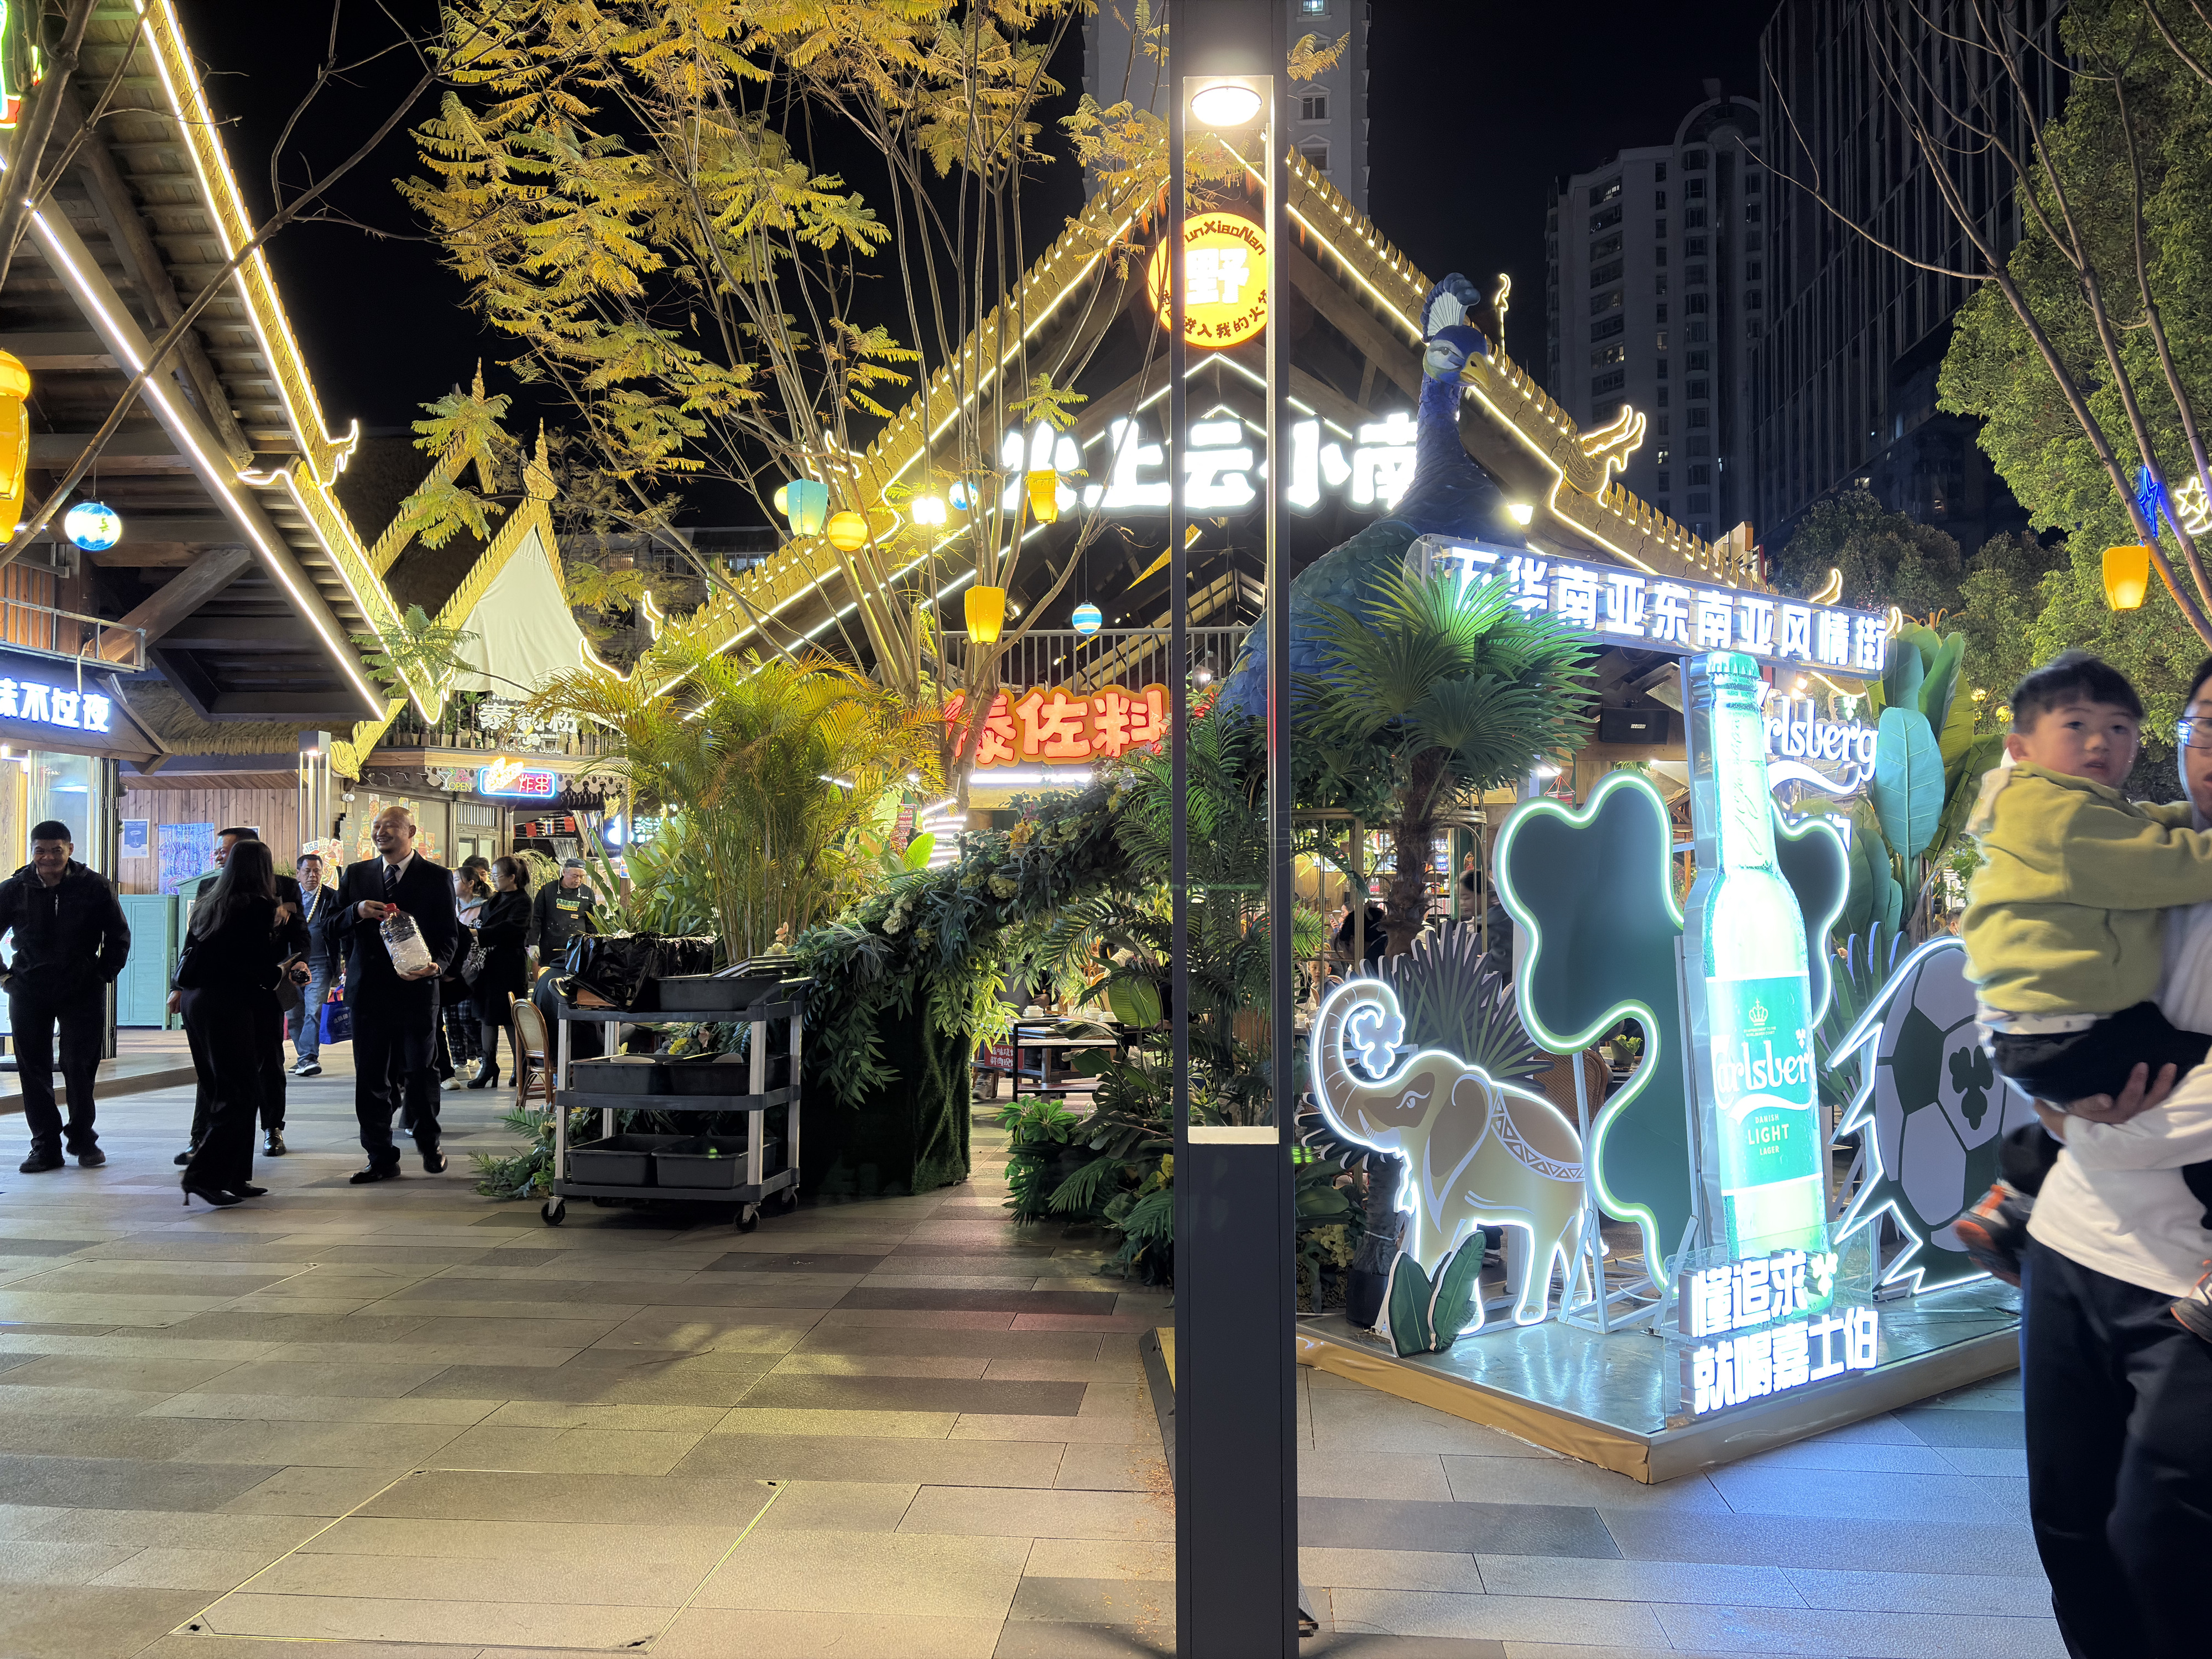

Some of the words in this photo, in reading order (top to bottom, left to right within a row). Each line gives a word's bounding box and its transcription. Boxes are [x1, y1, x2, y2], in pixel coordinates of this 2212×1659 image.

[1185, 221, 1266, 255] unXiaoNan
[1186, 248, 1250, 305] 野
[1756, 681, 1879, 781] rlsberg
[449, 782, 472, 791] OPEN
[519, 774, 550, 795] 炸串
[1755, 1113, 1780, 1124] DANISH
[1747, 1124, 1790, 1145] LIGHT
[1760, 1145, 1780, 1155] LAGER
[1691, 1250, 1807, 1338] 懂追求
[1693, 1306, 1879, 1414] 就喝嘉士伯
